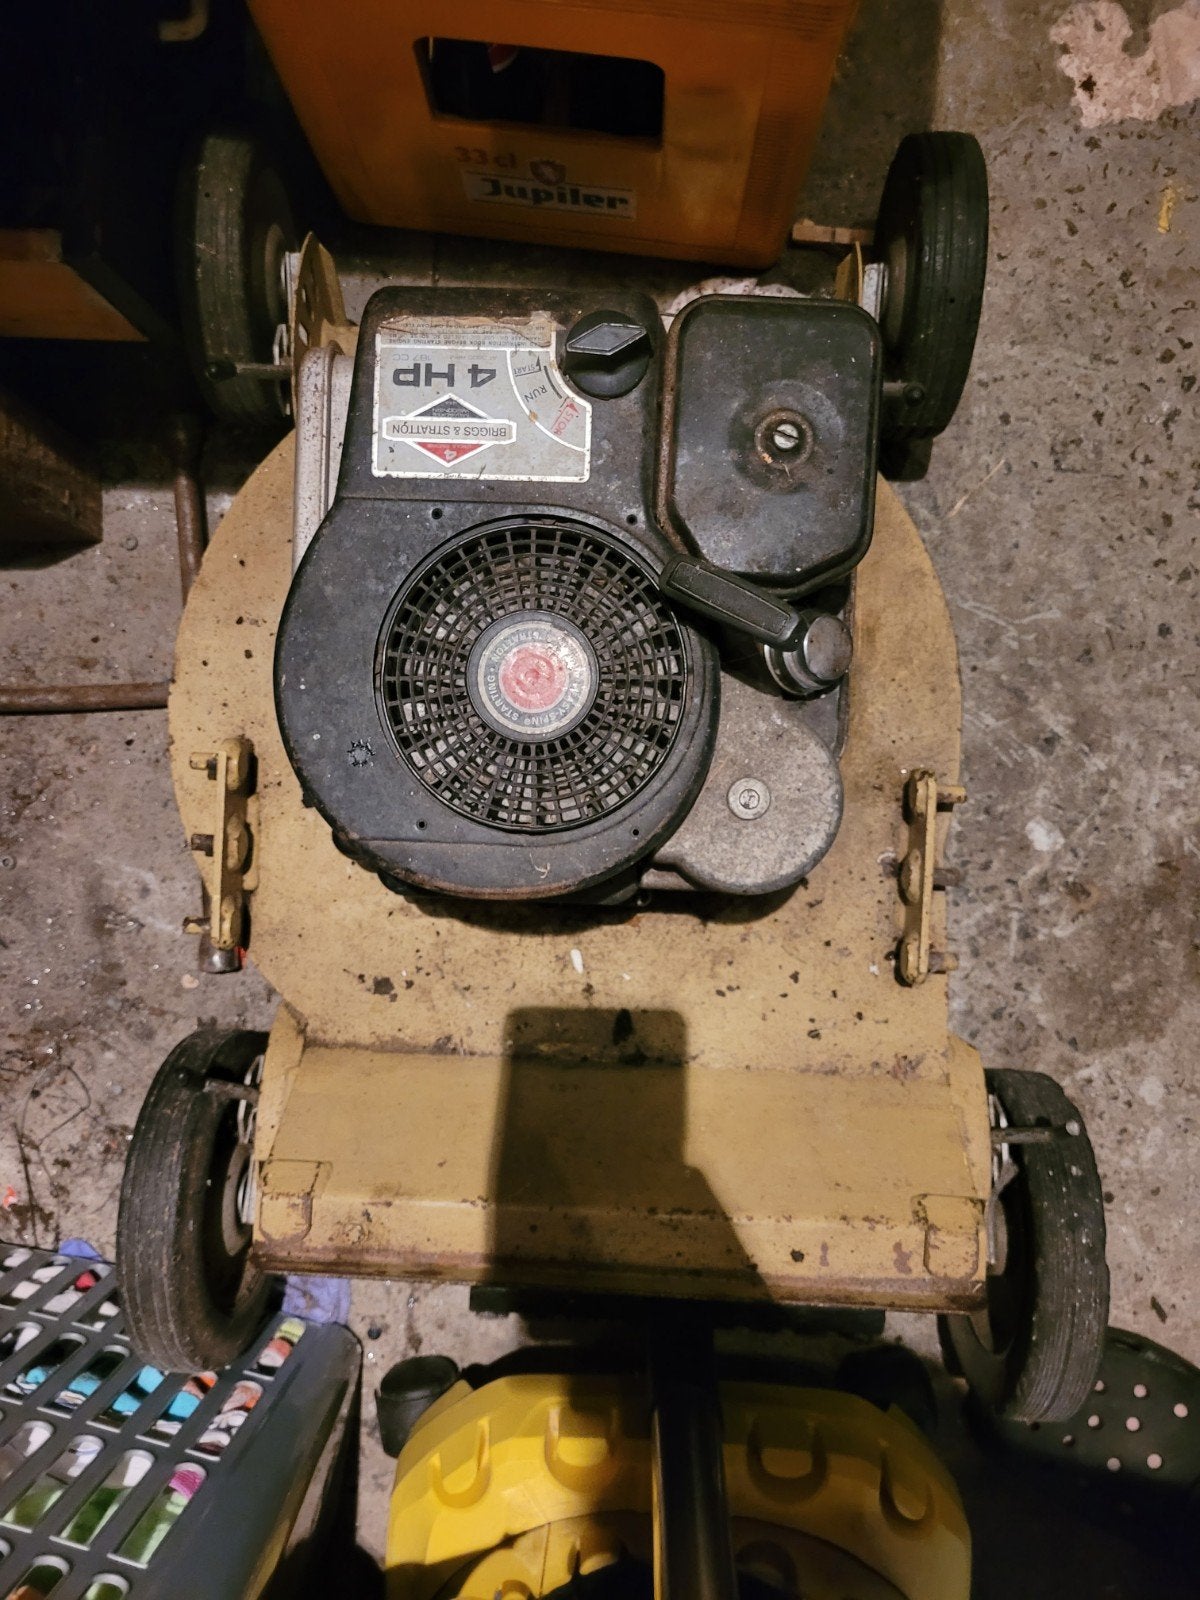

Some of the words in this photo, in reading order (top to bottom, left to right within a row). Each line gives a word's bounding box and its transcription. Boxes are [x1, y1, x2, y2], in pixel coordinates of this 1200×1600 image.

[454, 146, 487, 164] 33
[480, 177, 629, 210] Jupiler
[392, 353, 410, 361] CC
[414, 354, 432, 362] 187
[392, 363, 456, 388] HP
[467, 364, 497, 389] 4
[513, 363, 536, 376] START
[523, 384, 548, 404] RUN
[391, 424, 451, 436] STRATTON
[453, 426, 461, 436] &
[463, 426, 507, 437] BRIGGS
[487, 674, 520, 720] STARTING
